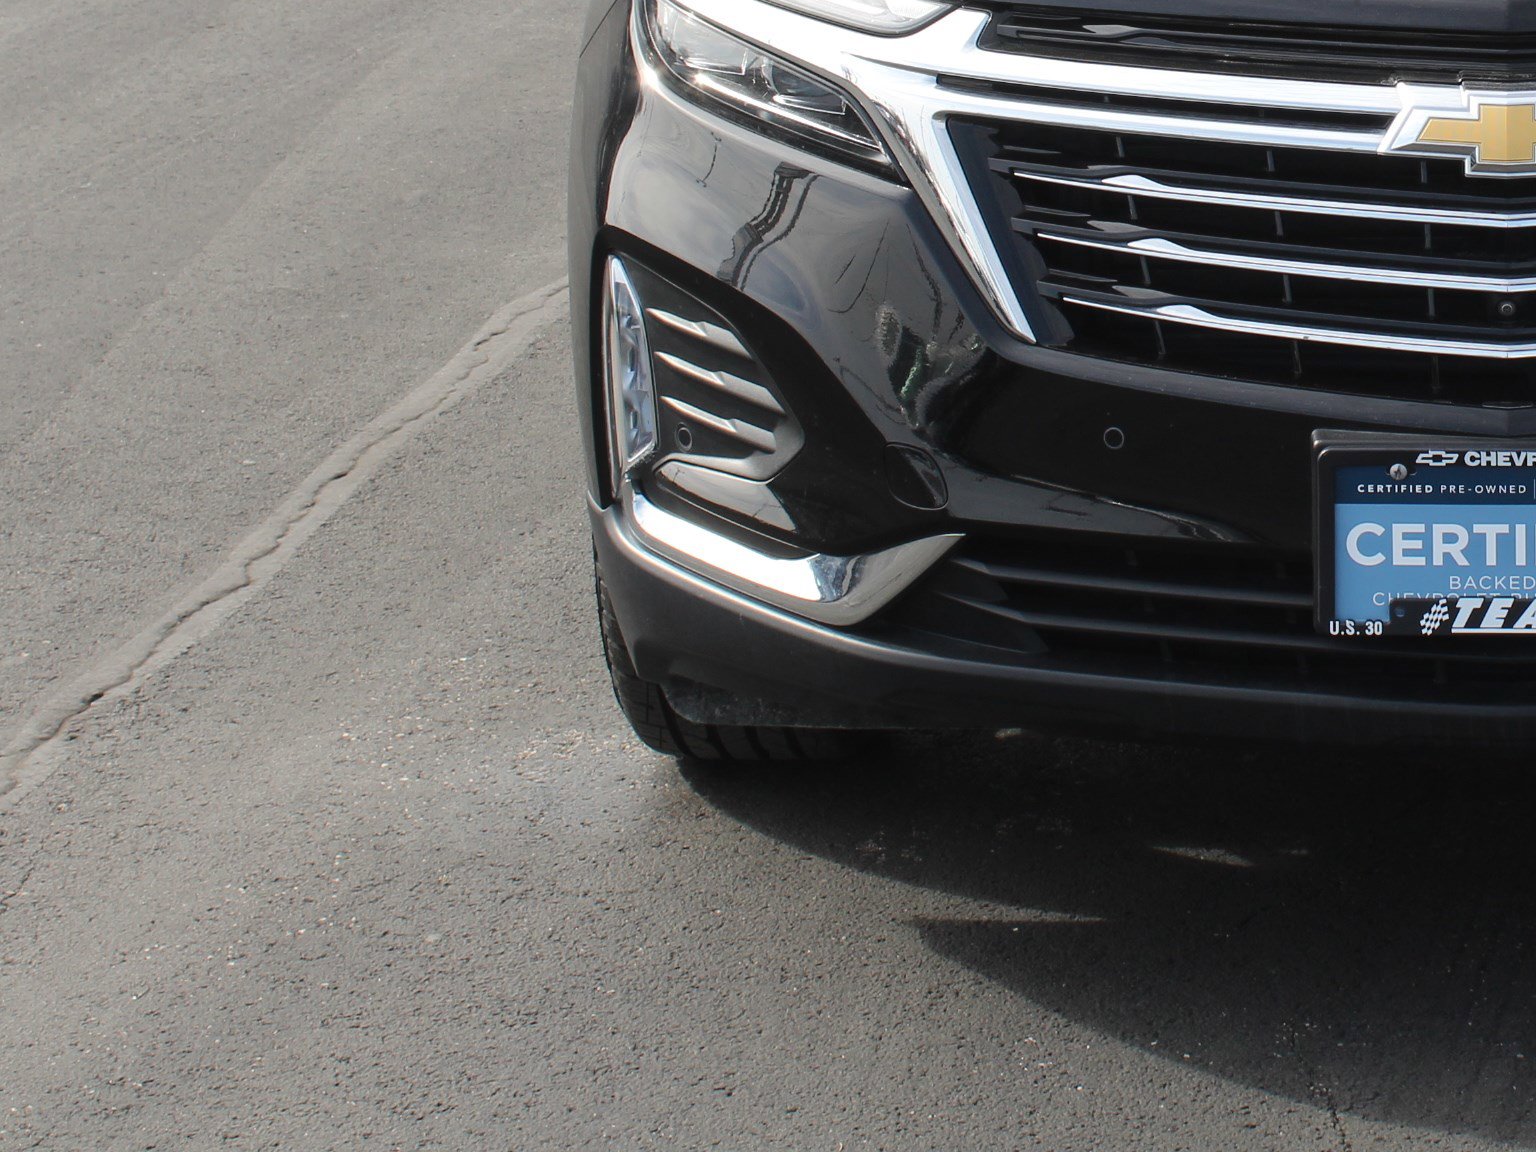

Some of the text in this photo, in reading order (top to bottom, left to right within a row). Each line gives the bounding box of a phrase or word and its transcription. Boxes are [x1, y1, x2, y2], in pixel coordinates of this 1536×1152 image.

[1357, 484, 1434, 494] CERTIFIED
[1440, 485, 1527, 494] PRE-OWNED
[1450, 575, 1536, 590] BACKED
[1329, 620, 1383, 636] U.S. 30
